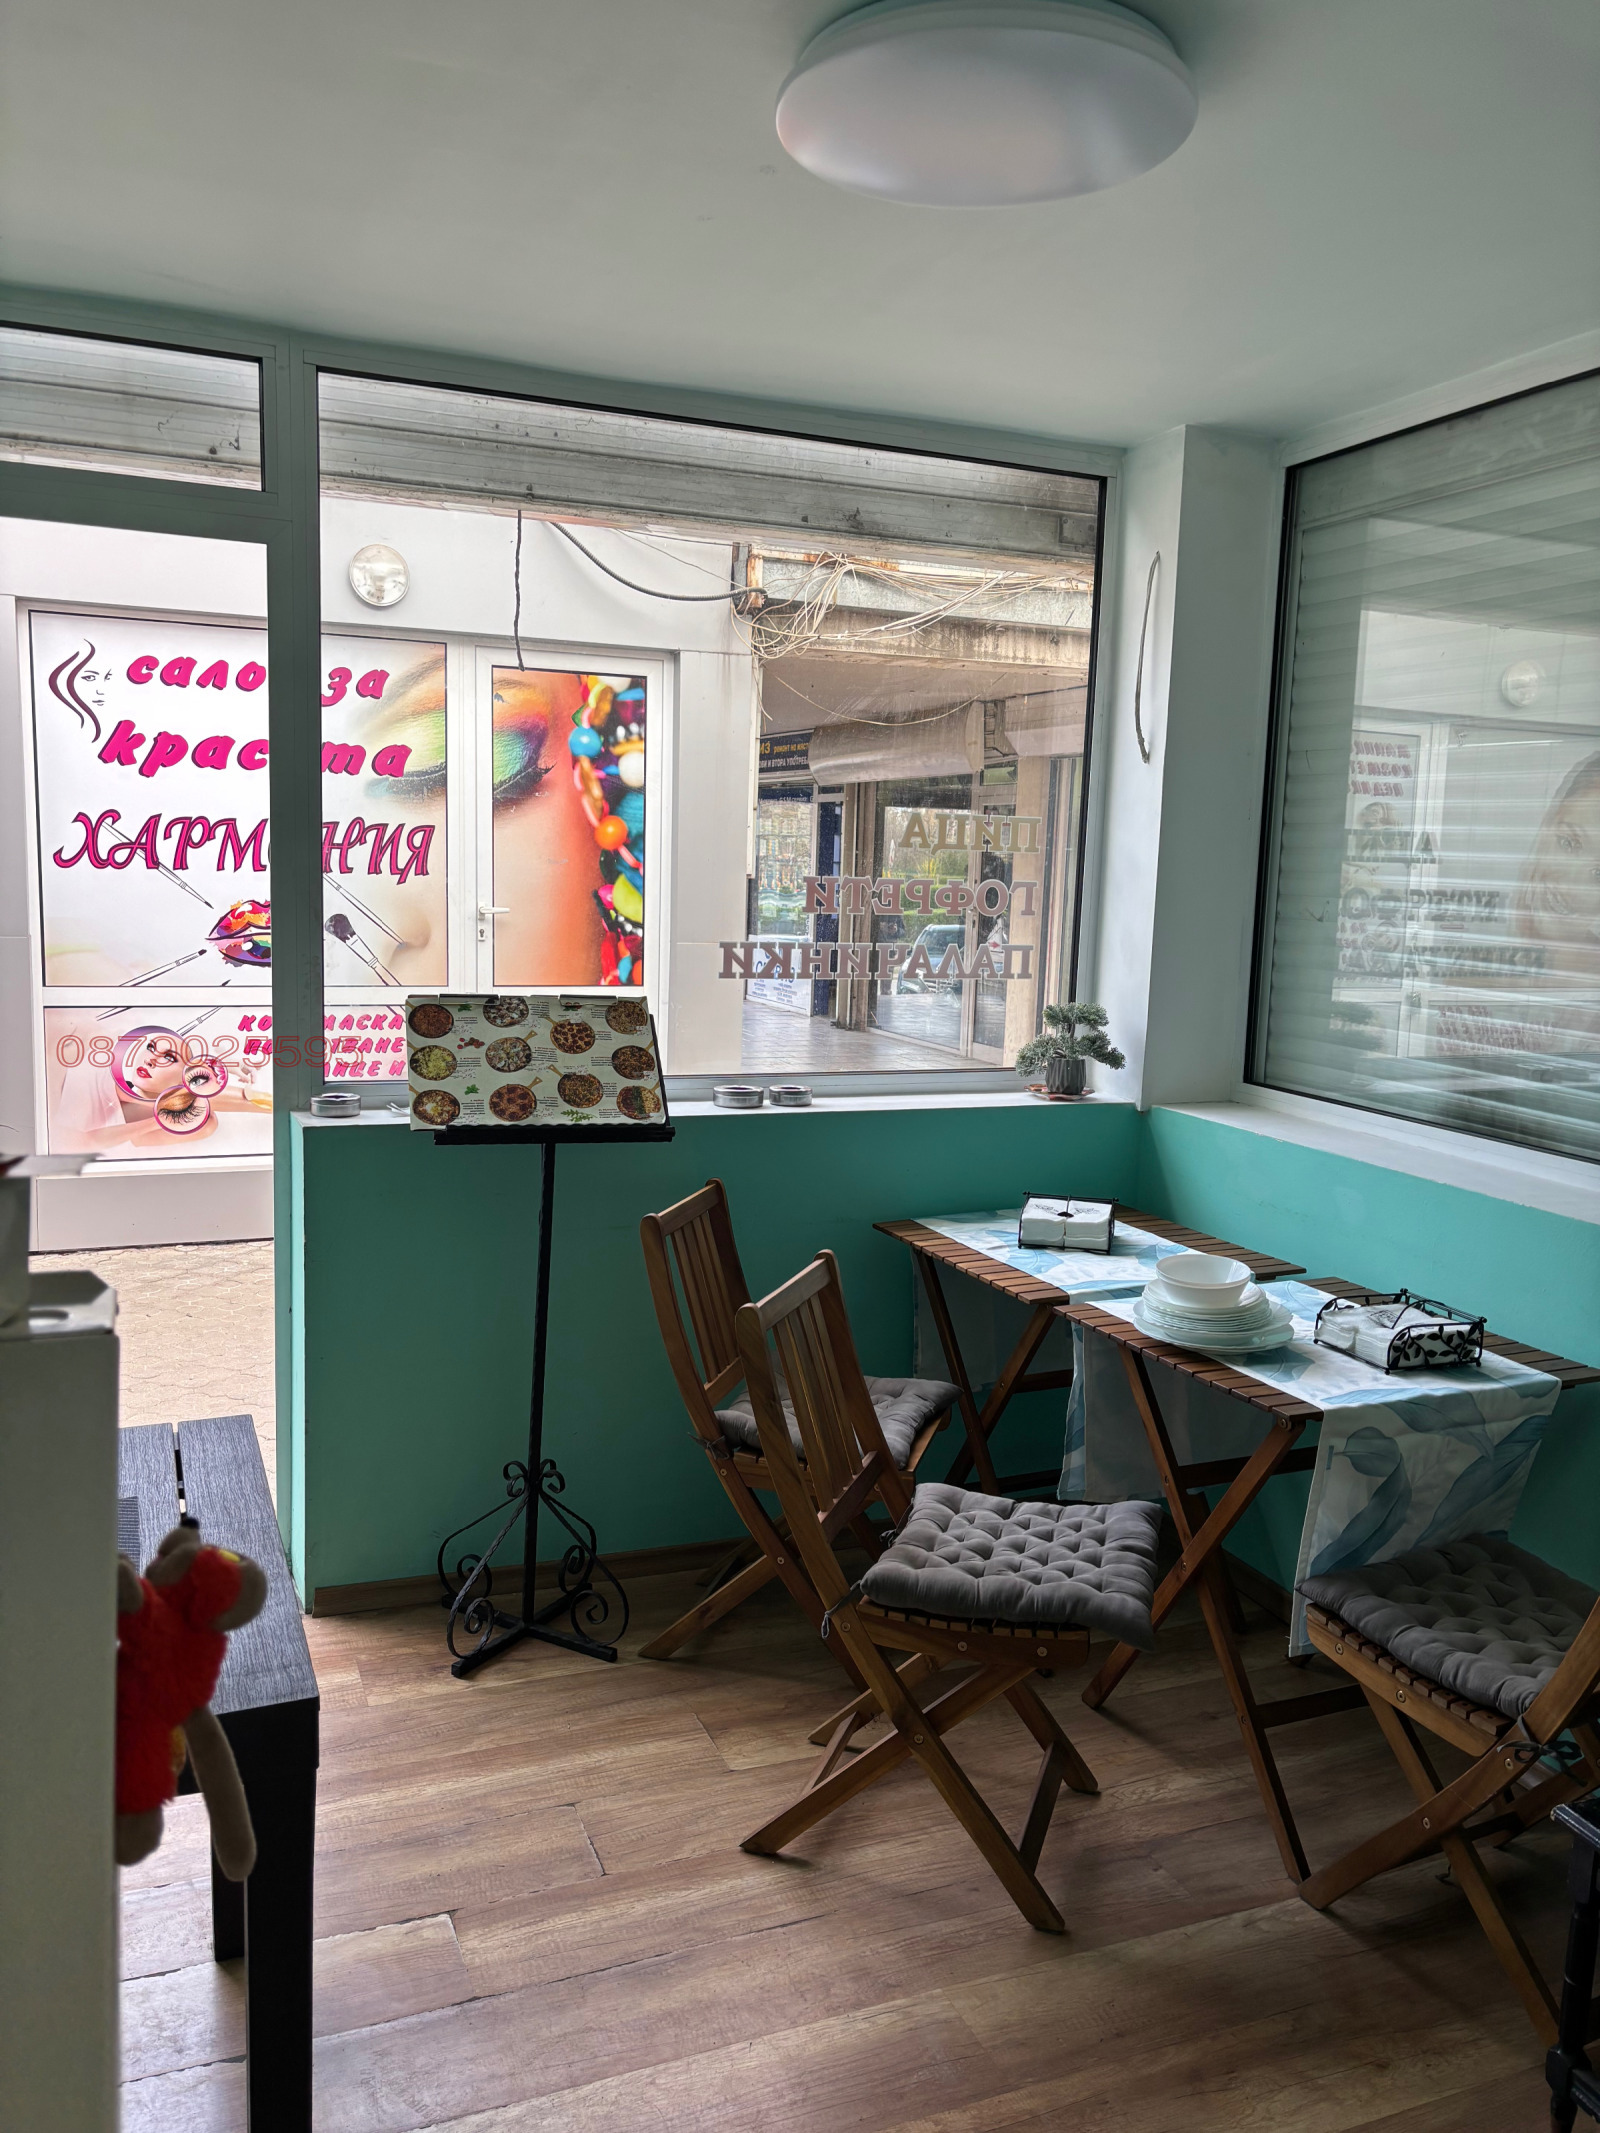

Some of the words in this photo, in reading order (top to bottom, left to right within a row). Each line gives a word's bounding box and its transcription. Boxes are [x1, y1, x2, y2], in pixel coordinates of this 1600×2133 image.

[127, 655, 267, 691] сало
[321, 666, 390, 708] за
[99, 719, 413, 777] краста
[53, 809, 436, 885] ХАРМНИЯ
